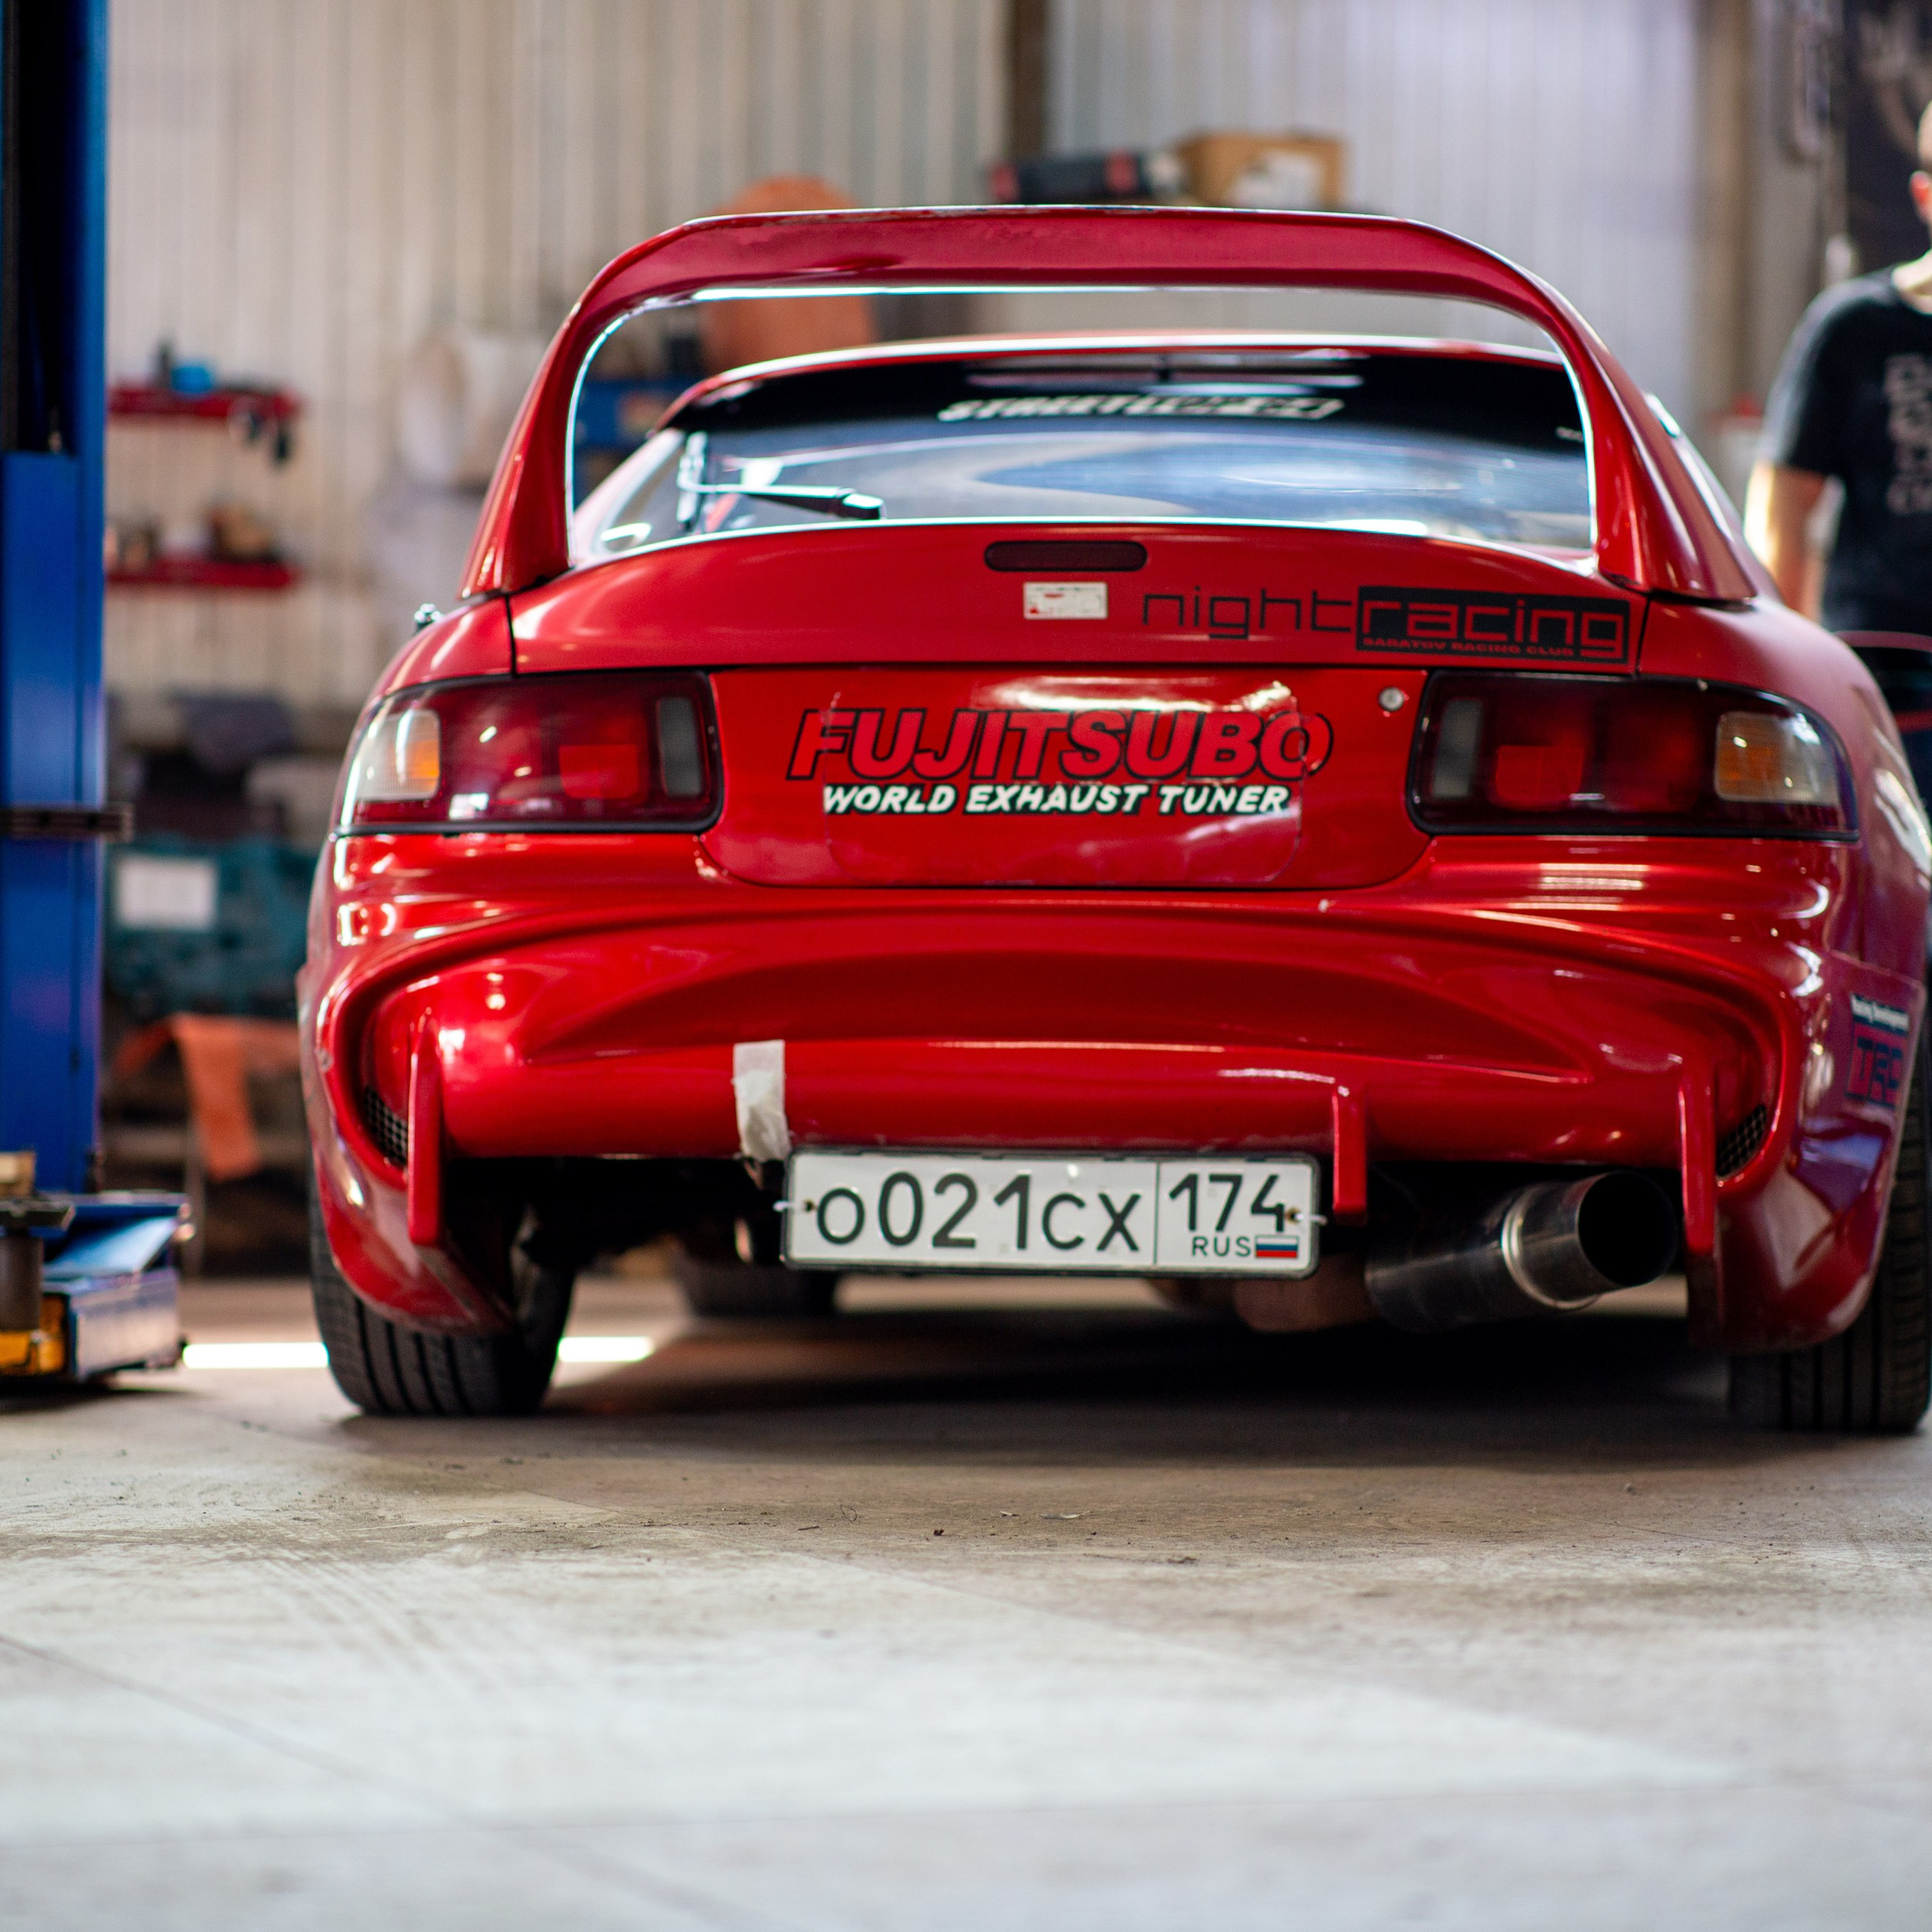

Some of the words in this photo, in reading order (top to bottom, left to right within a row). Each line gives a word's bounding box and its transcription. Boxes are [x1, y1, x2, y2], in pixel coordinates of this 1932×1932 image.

[1143, 586, 1352, 639] night
[1361, 598, 1626, 659] racing
[1451, 641, 1521, 655] RACING
[1526, 645, 1574, 657] CLUB
[786, 709, 1334, 782] FUJITSUBO
[823, 784, 958, 816] WORLD
[964, 784, 1149, 816] EXHAUST
[1158, 784, 1291, 816] TUNER
[1168, 1173, 1286, 1232] 174
[1192, 1235, 1251, 1258] RUS
